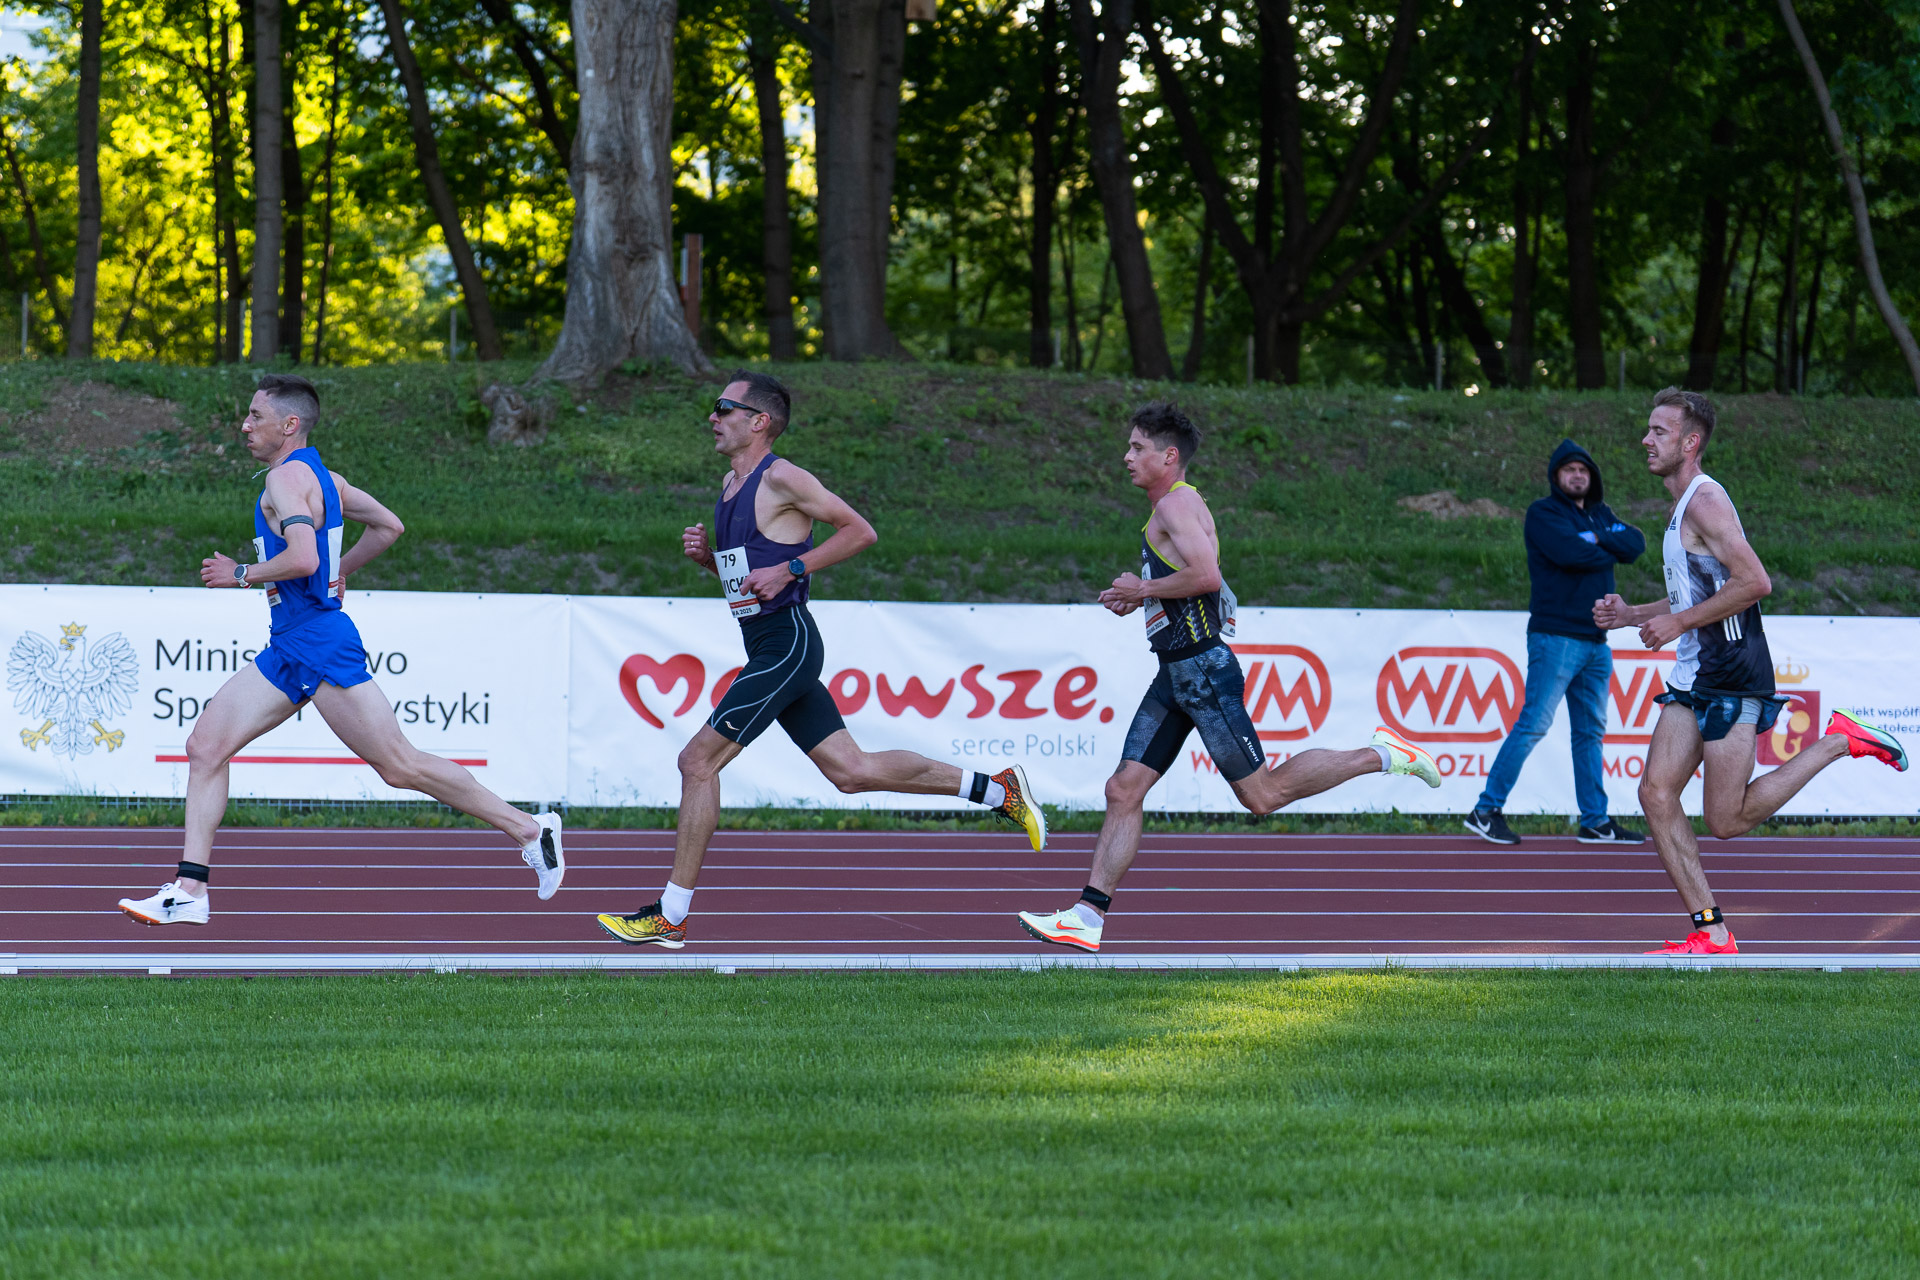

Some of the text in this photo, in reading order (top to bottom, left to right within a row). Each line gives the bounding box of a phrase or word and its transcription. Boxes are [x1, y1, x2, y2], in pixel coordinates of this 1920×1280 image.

[721, 553, 737, 568] 79
[155, 639, 407, 675] Miniswo
[951, 733, 1096, 757] serce Polski
